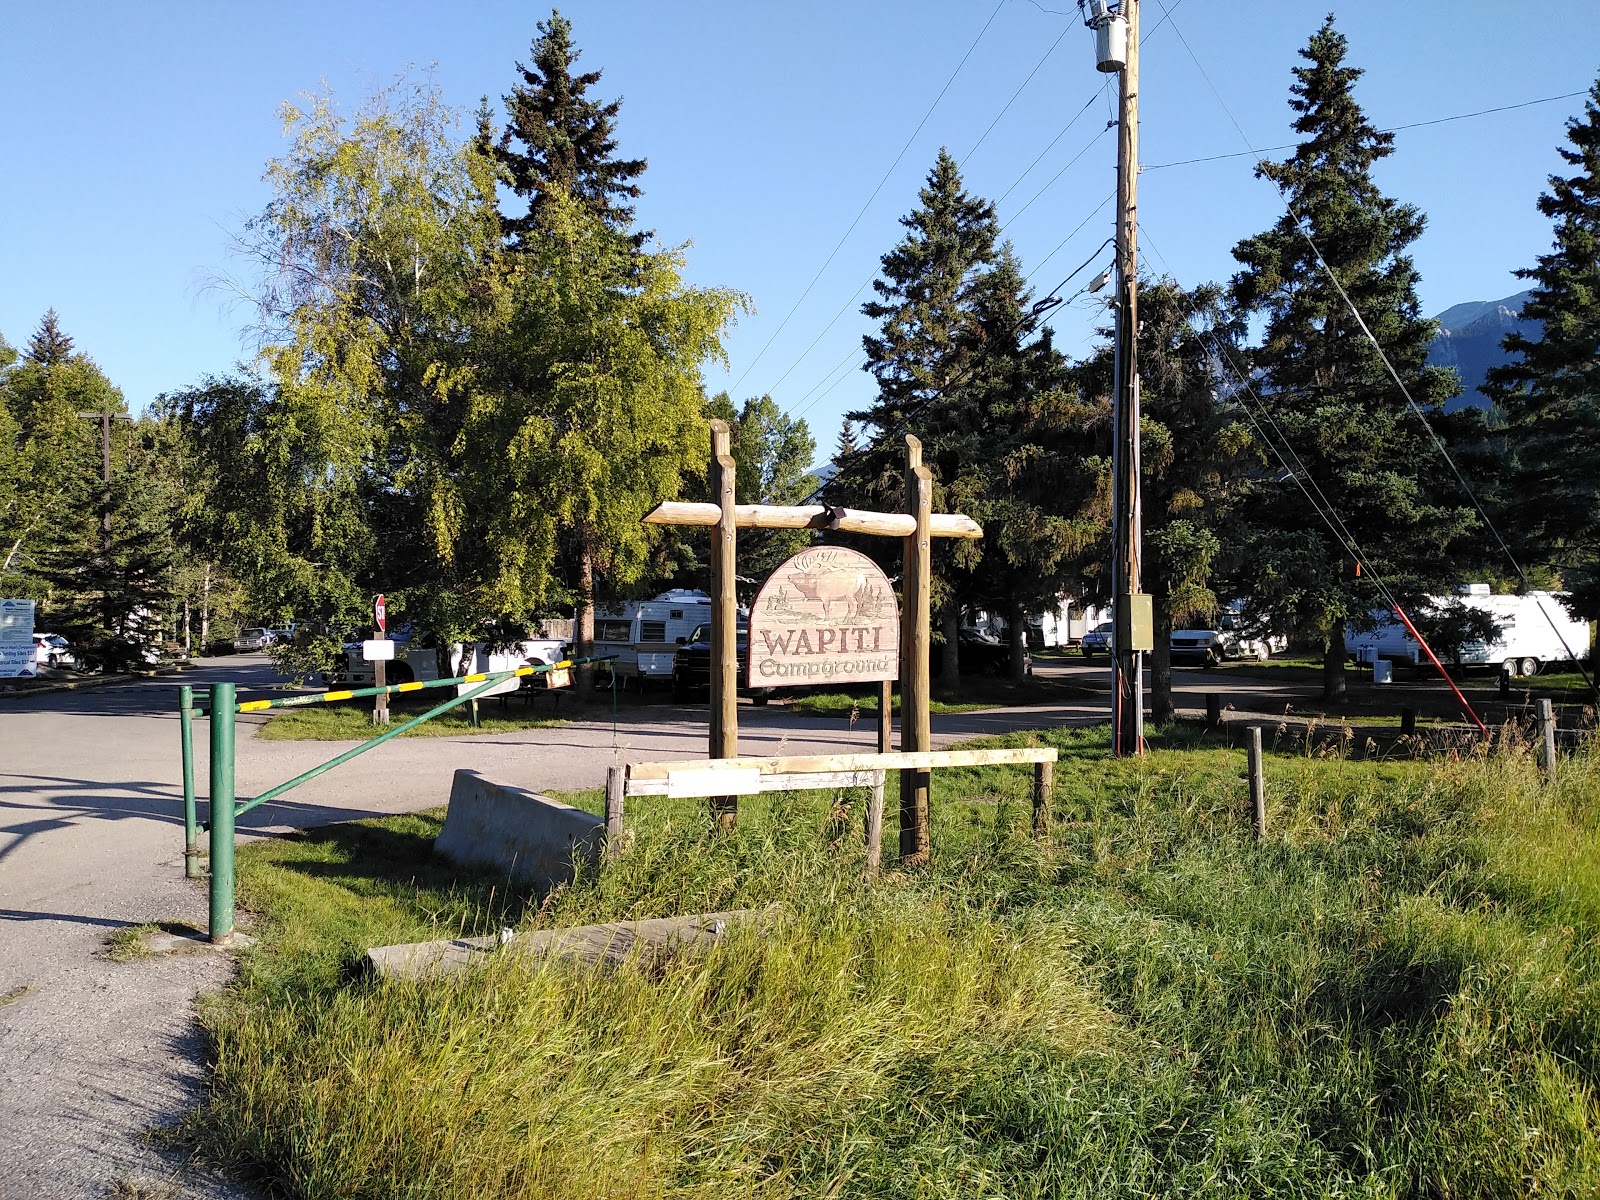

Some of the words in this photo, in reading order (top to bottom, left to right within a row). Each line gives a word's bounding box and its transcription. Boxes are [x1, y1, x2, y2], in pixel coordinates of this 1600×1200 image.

[377, 605, 385, 620] ST
[760, 627, 883, 656] WAPITI
[759, 655, 889, 679] Campground
